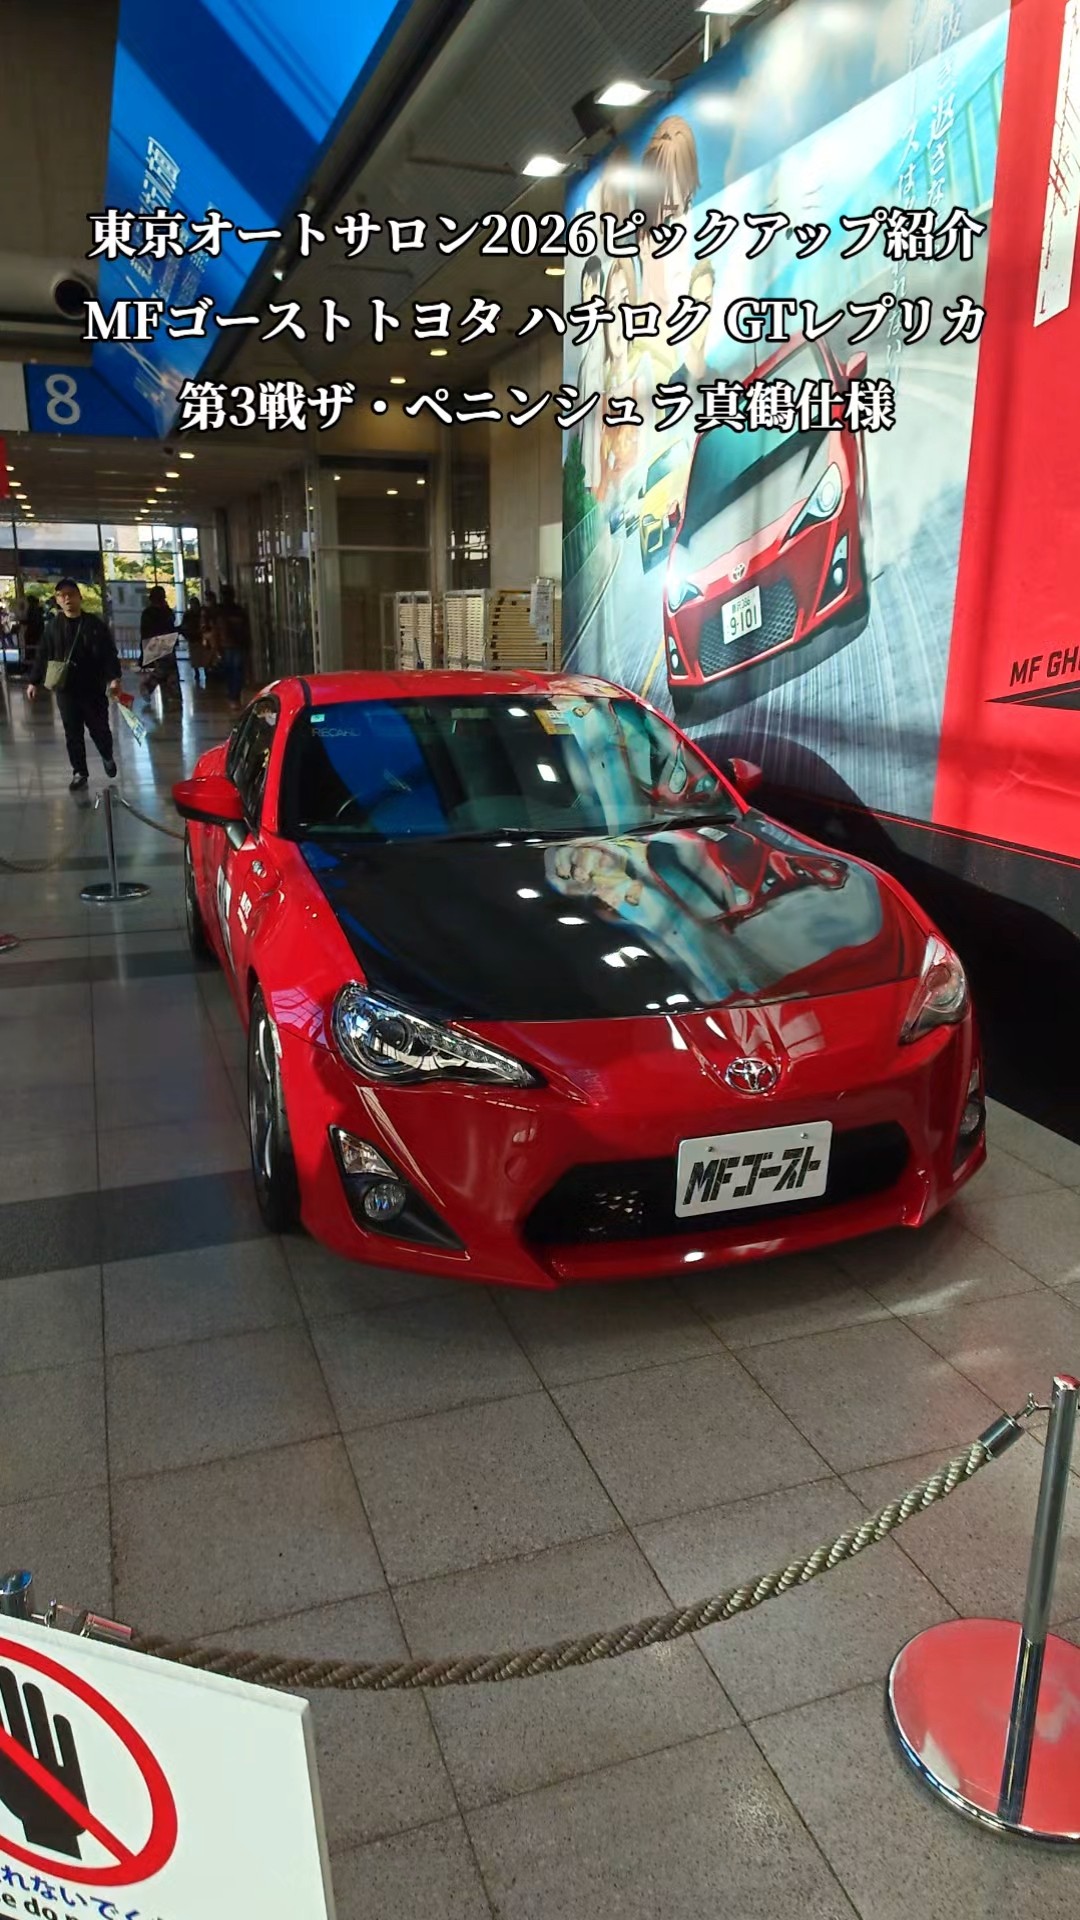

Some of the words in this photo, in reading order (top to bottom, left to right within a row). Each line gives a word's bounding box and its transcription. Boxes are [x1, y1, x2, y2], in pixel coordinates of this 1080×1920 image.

[45, 373, 81, 425] 8
[1009, 655, 1043, 687] MF
[1046, 645, 1080, 678] GH
[682, 1146, 822, 1205] MFゴースト
